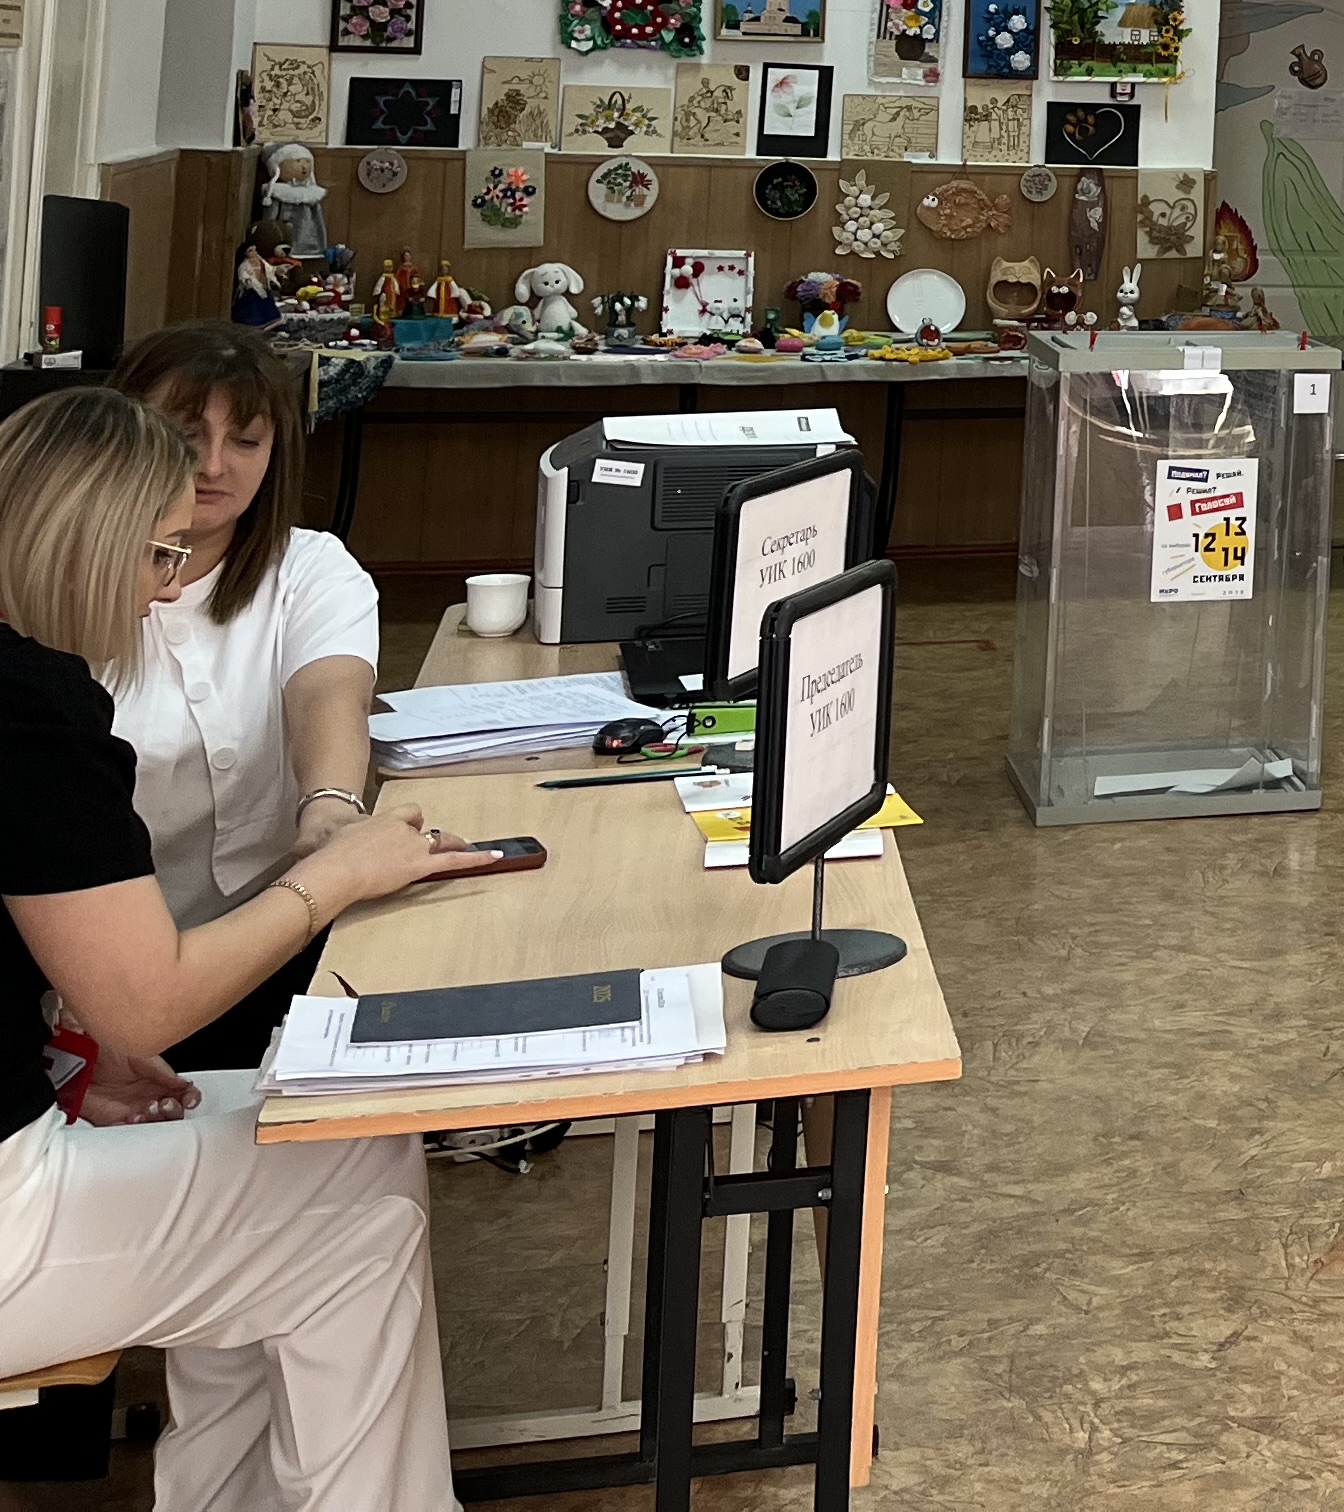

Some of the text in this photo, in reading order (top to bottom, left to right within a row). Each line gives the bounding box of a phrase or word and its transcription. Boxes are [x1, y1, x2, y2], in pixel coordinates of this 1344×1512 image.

[1309, 383, 1317, 396] 1
[1223, 516, 1247, 537] 13
[761, 524, 818, 557] Секретарь
[1192, 533, 1216, 552] 12
[1222, 546, 1246, 567] 14
[759, 548, 816, 588] УИК 1600
[1192, 574, 1245, 584] СЕНТЯБРЯ
[800, 652, 864, 705] Председатель
[809, 687, 855, 738] УИК 1600
